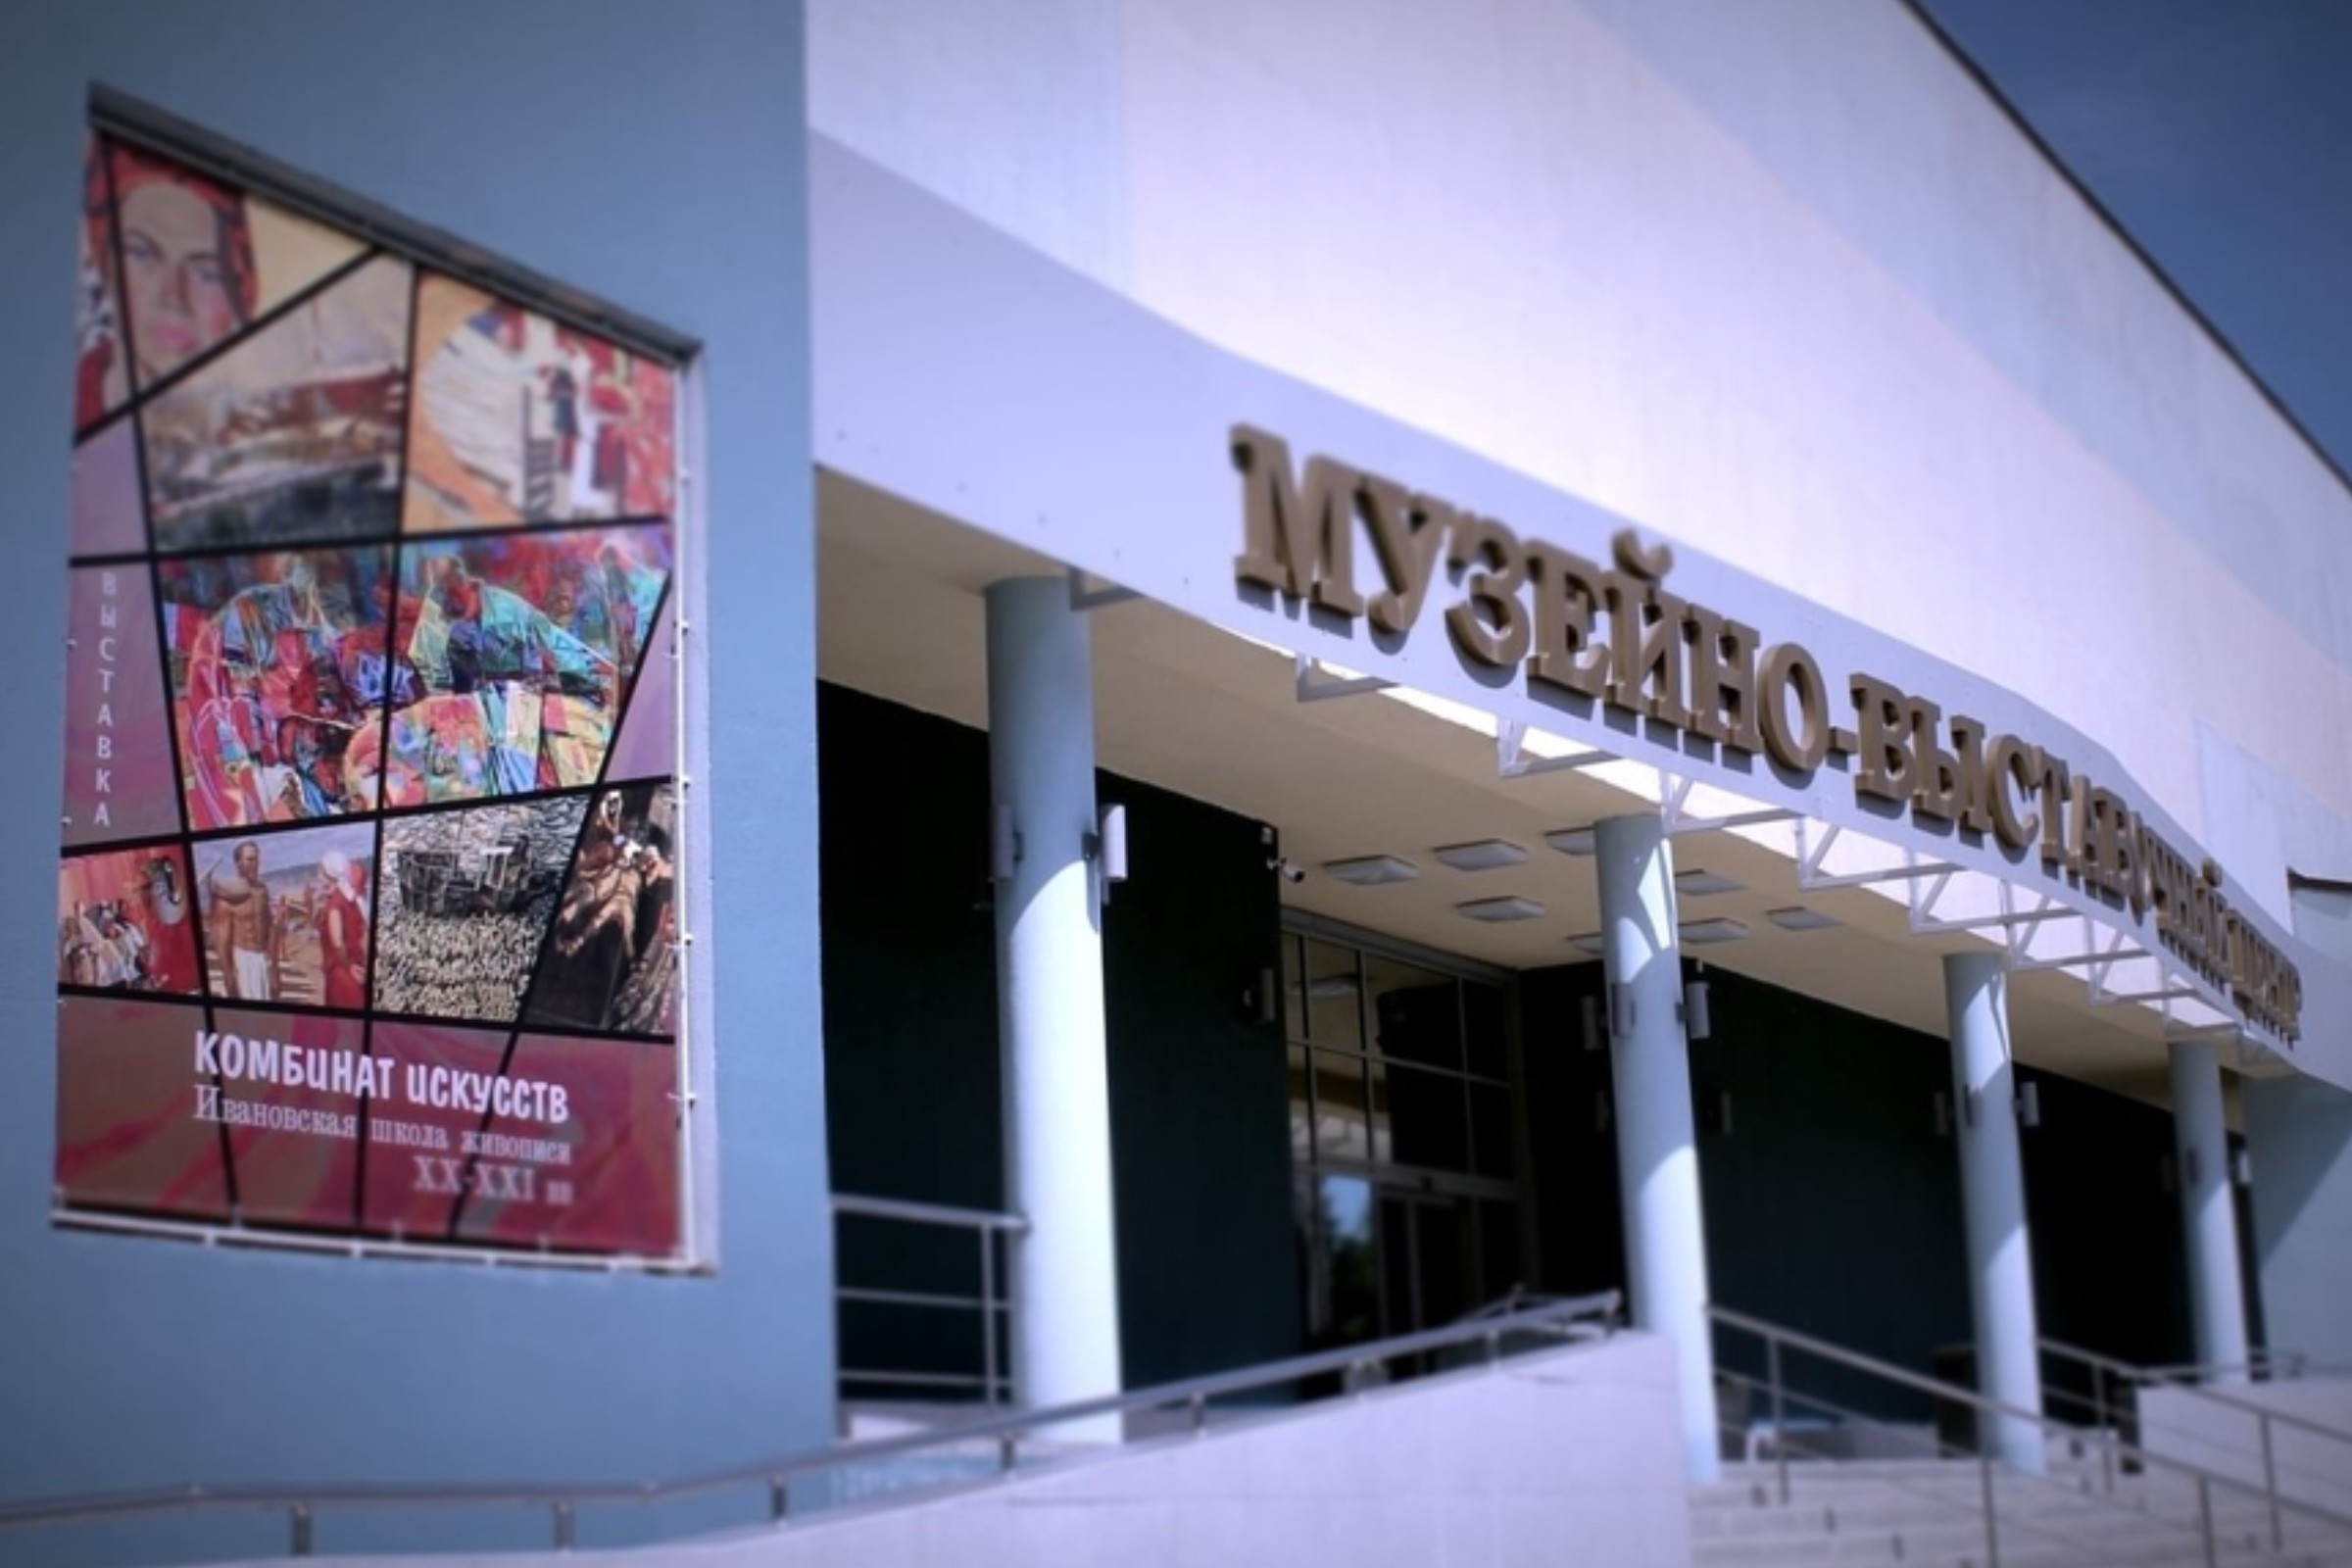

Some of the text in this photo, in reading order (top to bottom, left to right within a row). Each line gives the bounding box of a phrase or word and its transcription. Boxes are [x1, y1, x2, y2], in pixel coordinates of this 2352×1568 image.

[93, 572, 117, 826] ВЫСТАВКА
[193, 1084, 571, 1165] Ивановская школа живописи
